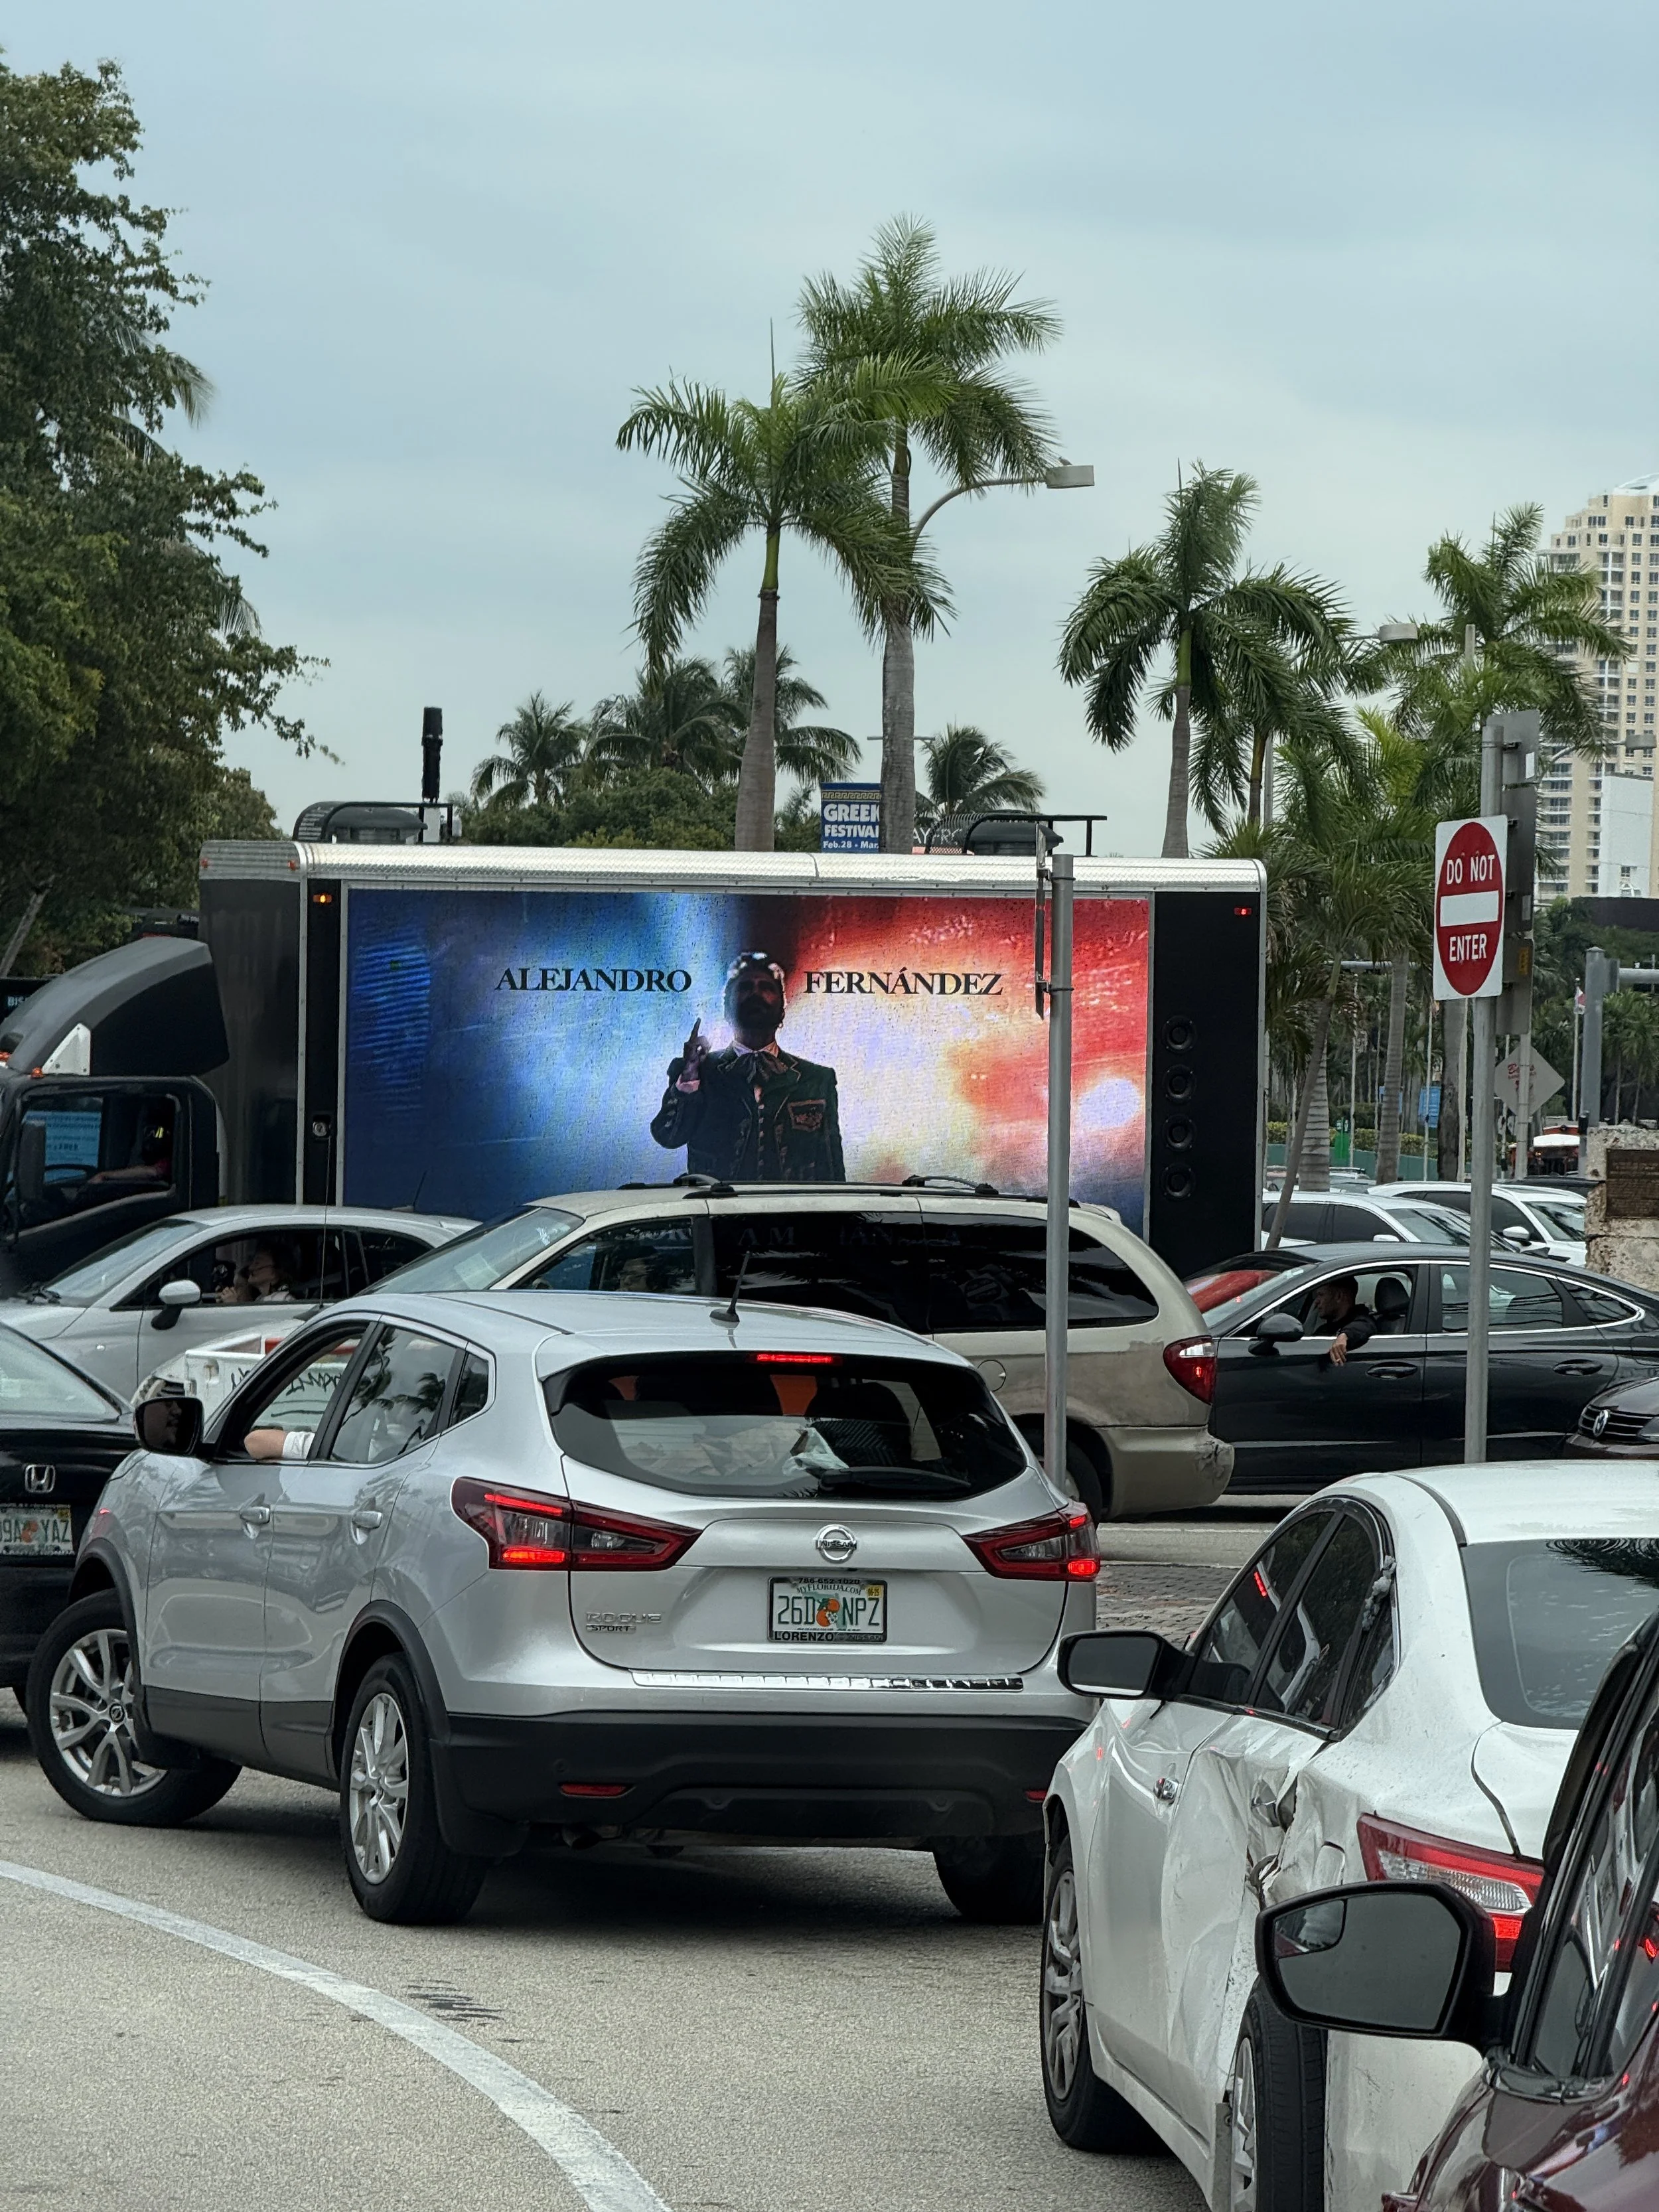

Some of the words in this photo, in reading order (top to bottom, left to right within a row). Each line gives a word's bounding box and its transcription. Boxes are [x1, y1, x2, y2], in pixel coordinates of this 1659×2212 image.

[824, 804, 879, 822] GREEK
[1446, 858, 1463, 885] DO
[1470, 854, 1494, 882] NOT
[1449, 933, 1487, 962] ENTER
[494, 968, 691, 993] ALEJANDRO
[803, 967, 1003, 995] FERNÁNDEZ
[820, 1539, 857, 1548] NISSAN
[842, 1597, 880, 1626] NPZ
[774, 1631, 835, 1642] LORENZO
